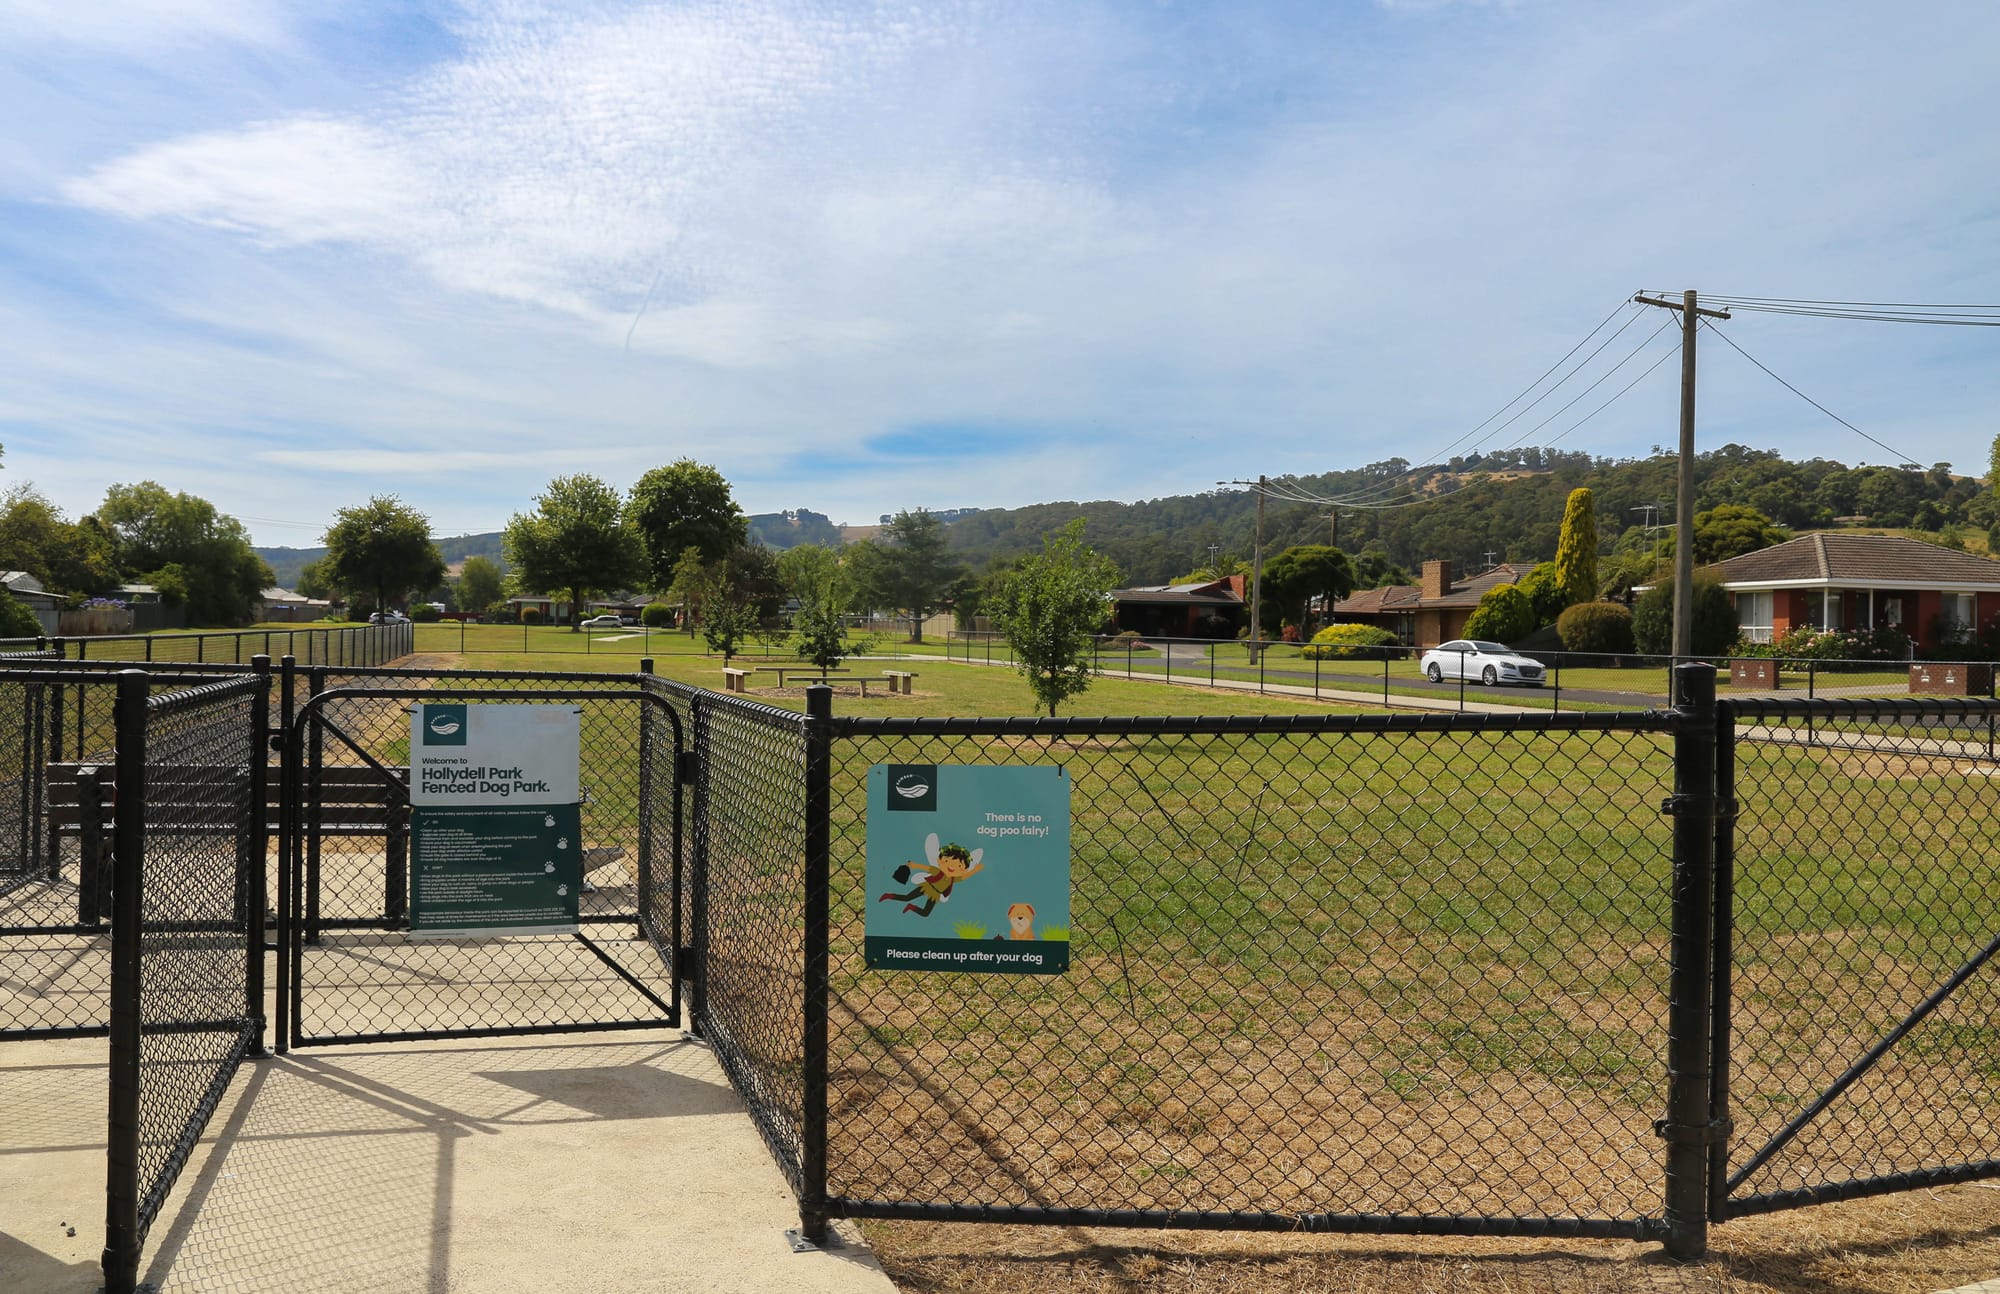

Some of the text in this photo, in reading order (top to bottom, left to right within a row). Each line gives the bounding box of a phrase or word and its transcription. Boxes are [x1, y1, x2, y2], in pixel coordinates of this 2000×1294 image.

[422, 757, 468, 765] Welcome to
[422, 767, 523, 783] Hollydell Park
[422, 779, 551, 797] Fenced Dog Park.
[985, 812, 1015, 822] There
[1017, 812, 1026, 822] is
[977, 825, 1049, 838] dog poo fairy!
[886, 949, 1043, 965] Please clean up after your dog
